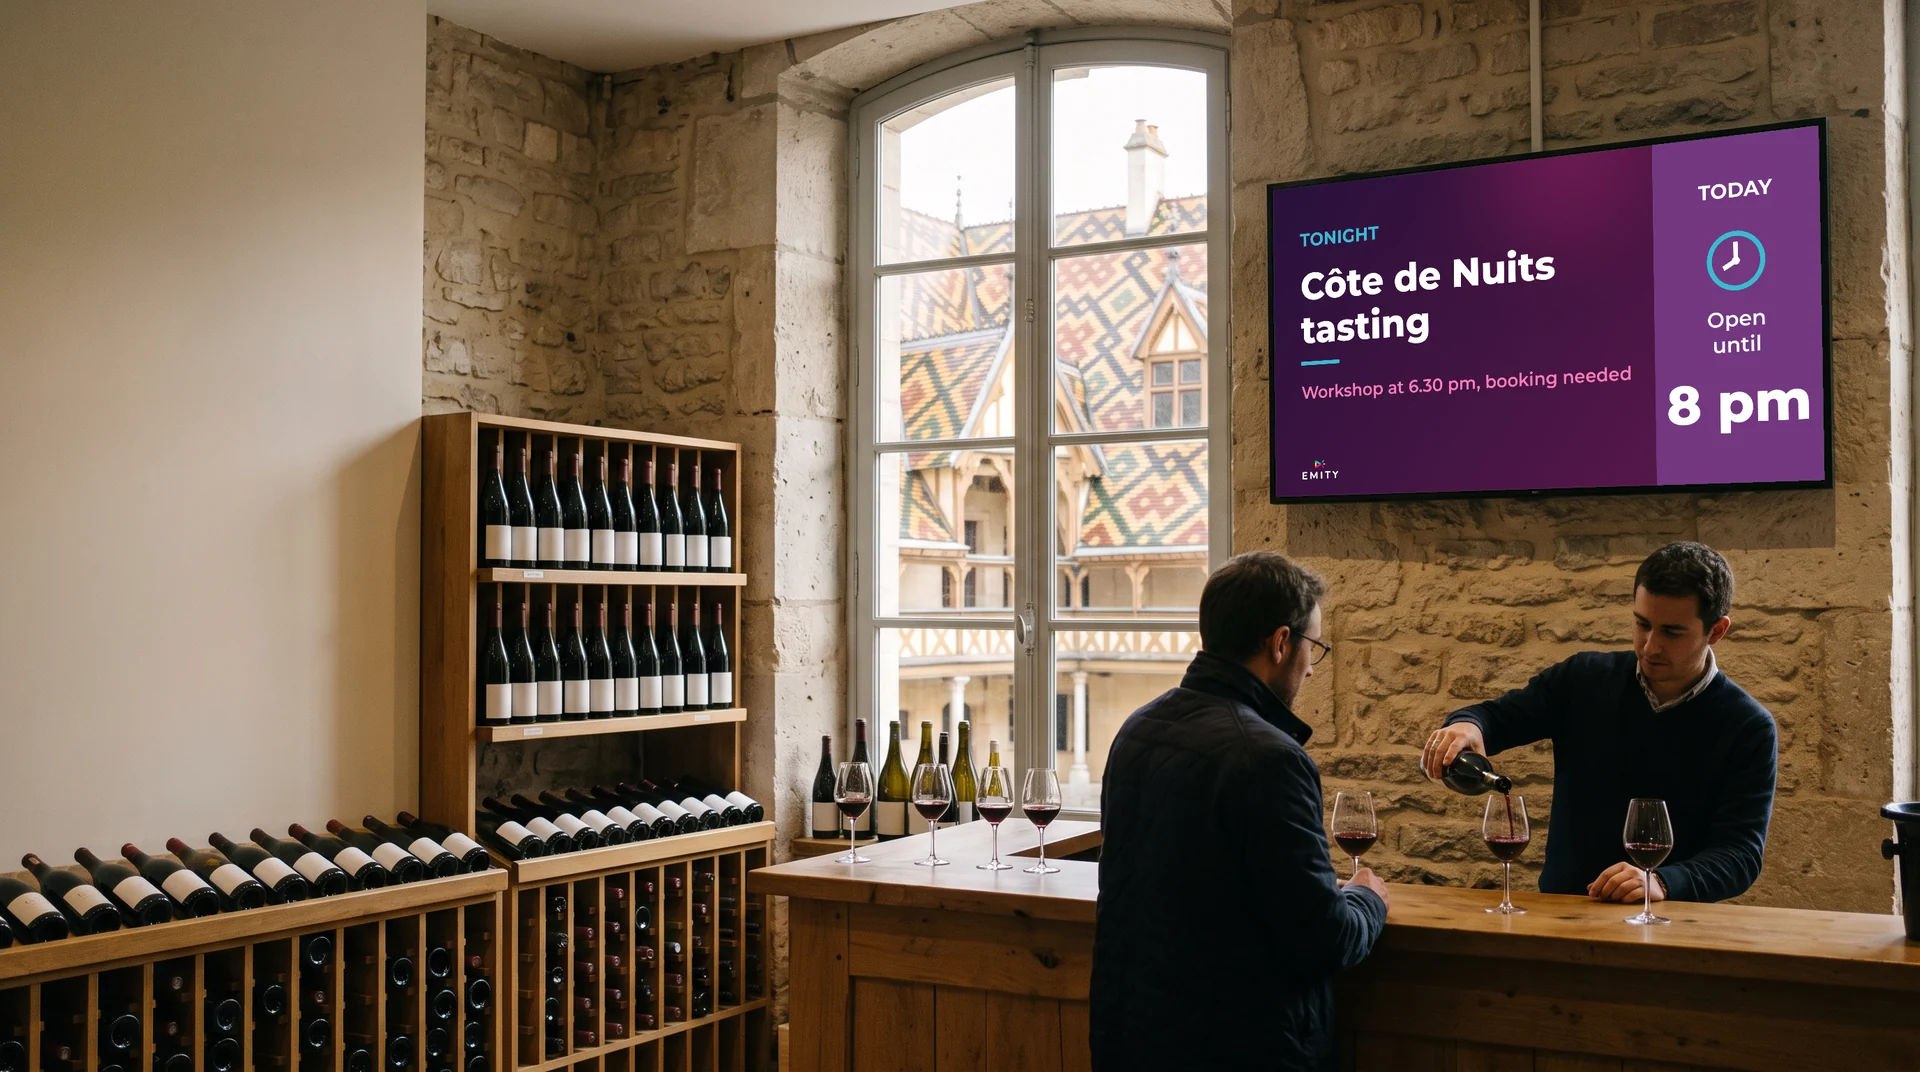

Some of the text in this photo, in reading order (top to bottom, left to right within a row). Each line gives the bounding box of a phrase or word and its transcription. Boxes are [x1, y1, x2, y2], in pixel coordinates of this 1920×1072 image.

[1698, 179, 1772, 201] TODAY
[1300, 226, 1379, 247] TONIGHT
[1301, 250, 1555, 300] Côte de Nuits
[1301, 307, 1429, 344] tasting
[1708, 312, 1766, 331] Open
[1713, 334, 1761, 354] until
[1302, 366, 1631, 399] Workshop at 6.30 pm, booking needed
[1668, 386, 1810, 434] 8 pm
[1302, 471, 1339, 480] EMITY
